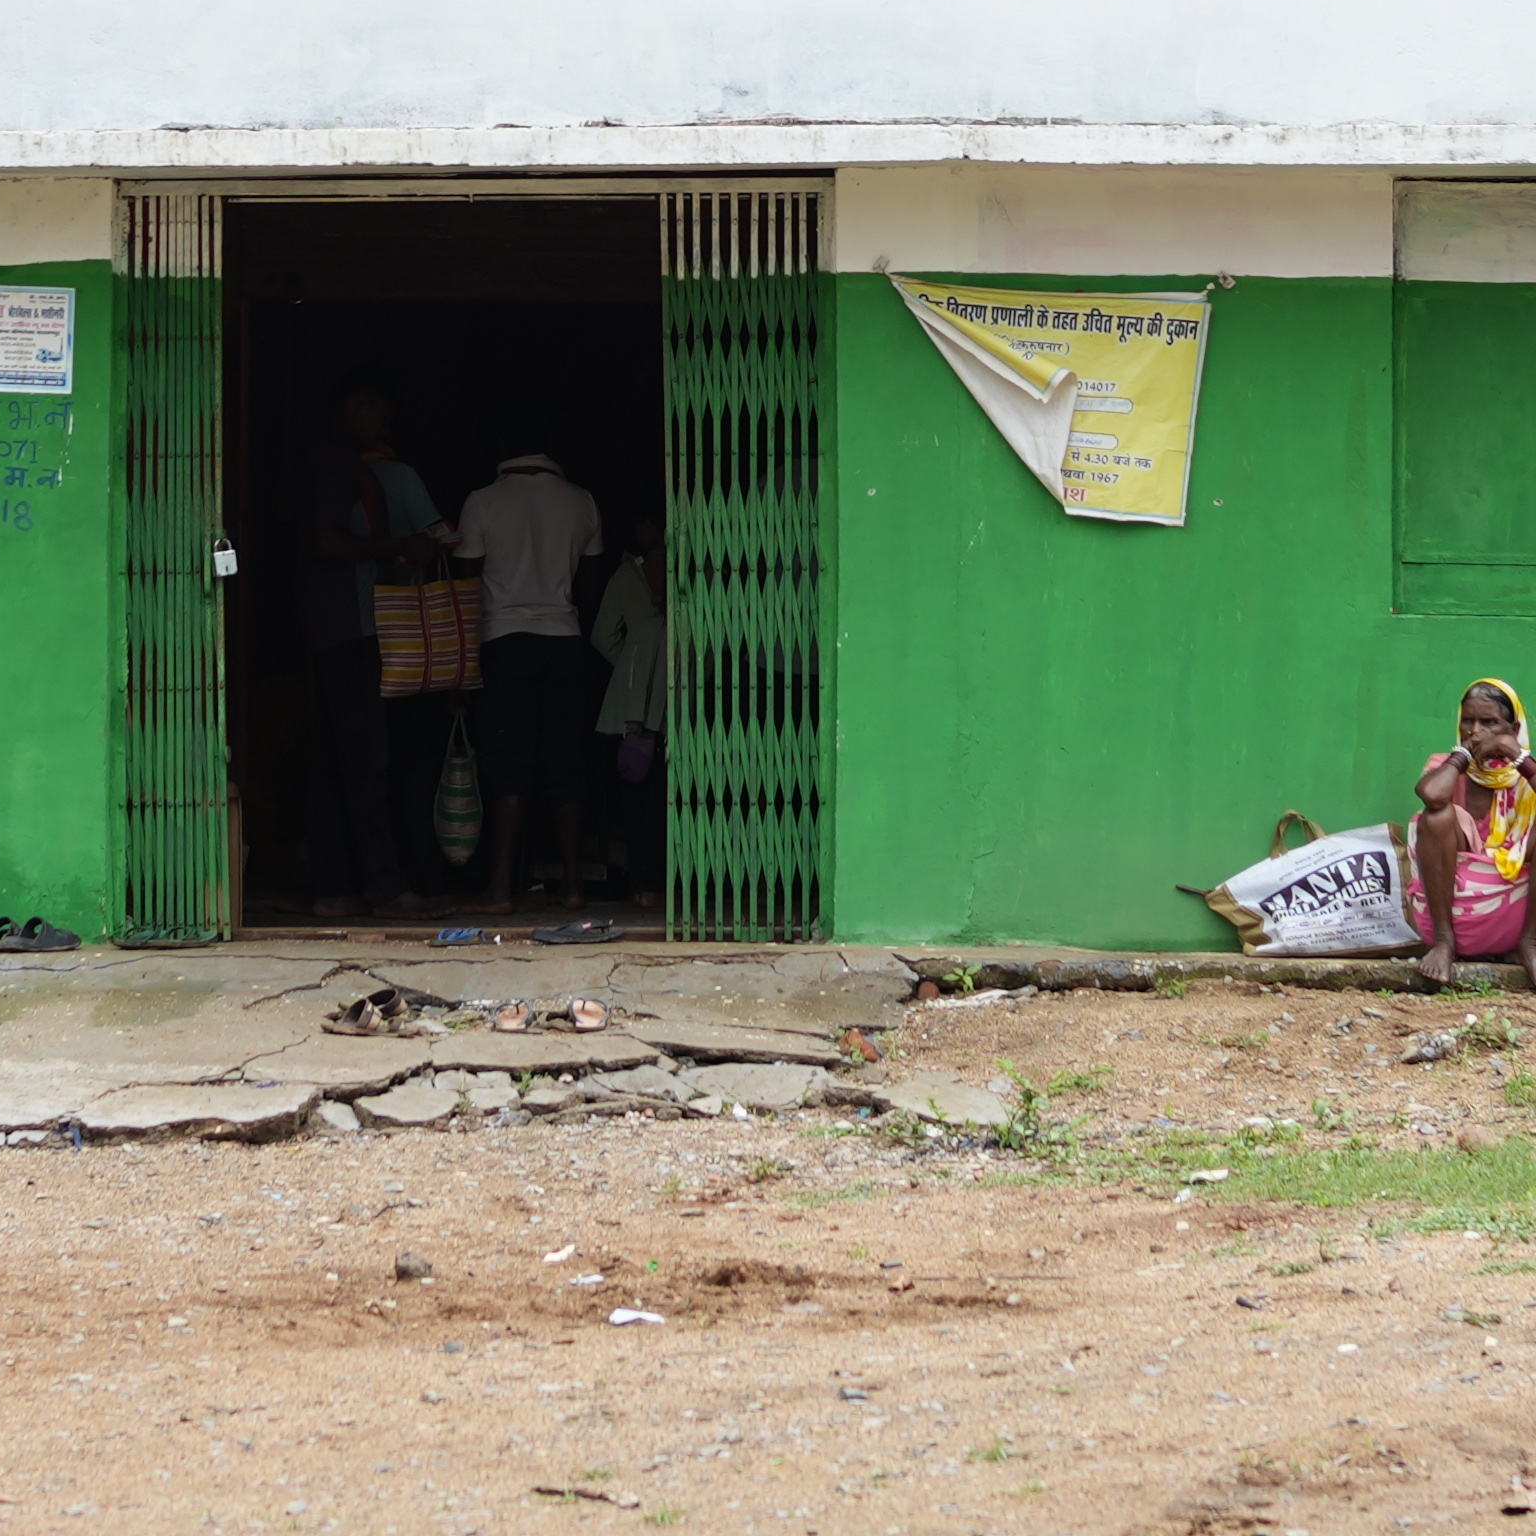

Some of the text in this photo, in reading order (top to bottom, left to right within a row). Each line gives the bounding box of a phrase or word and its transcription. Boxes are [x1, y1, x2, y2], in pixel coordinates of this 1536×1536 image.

[991, 304, 1035, 329] प्रणाली
[1037, 305, 1049, 329] के
[1052, 311, 1079, 331] तहत
[1082, 308, 1113, 334] उचित
[1116, 315, 1145, 343] मूल्य
[1147, 312, 1163, 337] की
[1166, 318, 1200, 345] दुकान
[1084, 452, 1109, 465] 4.30
[1134, 457, 1153, 469] तक
[1091, 471, 1119, 484] 1967
